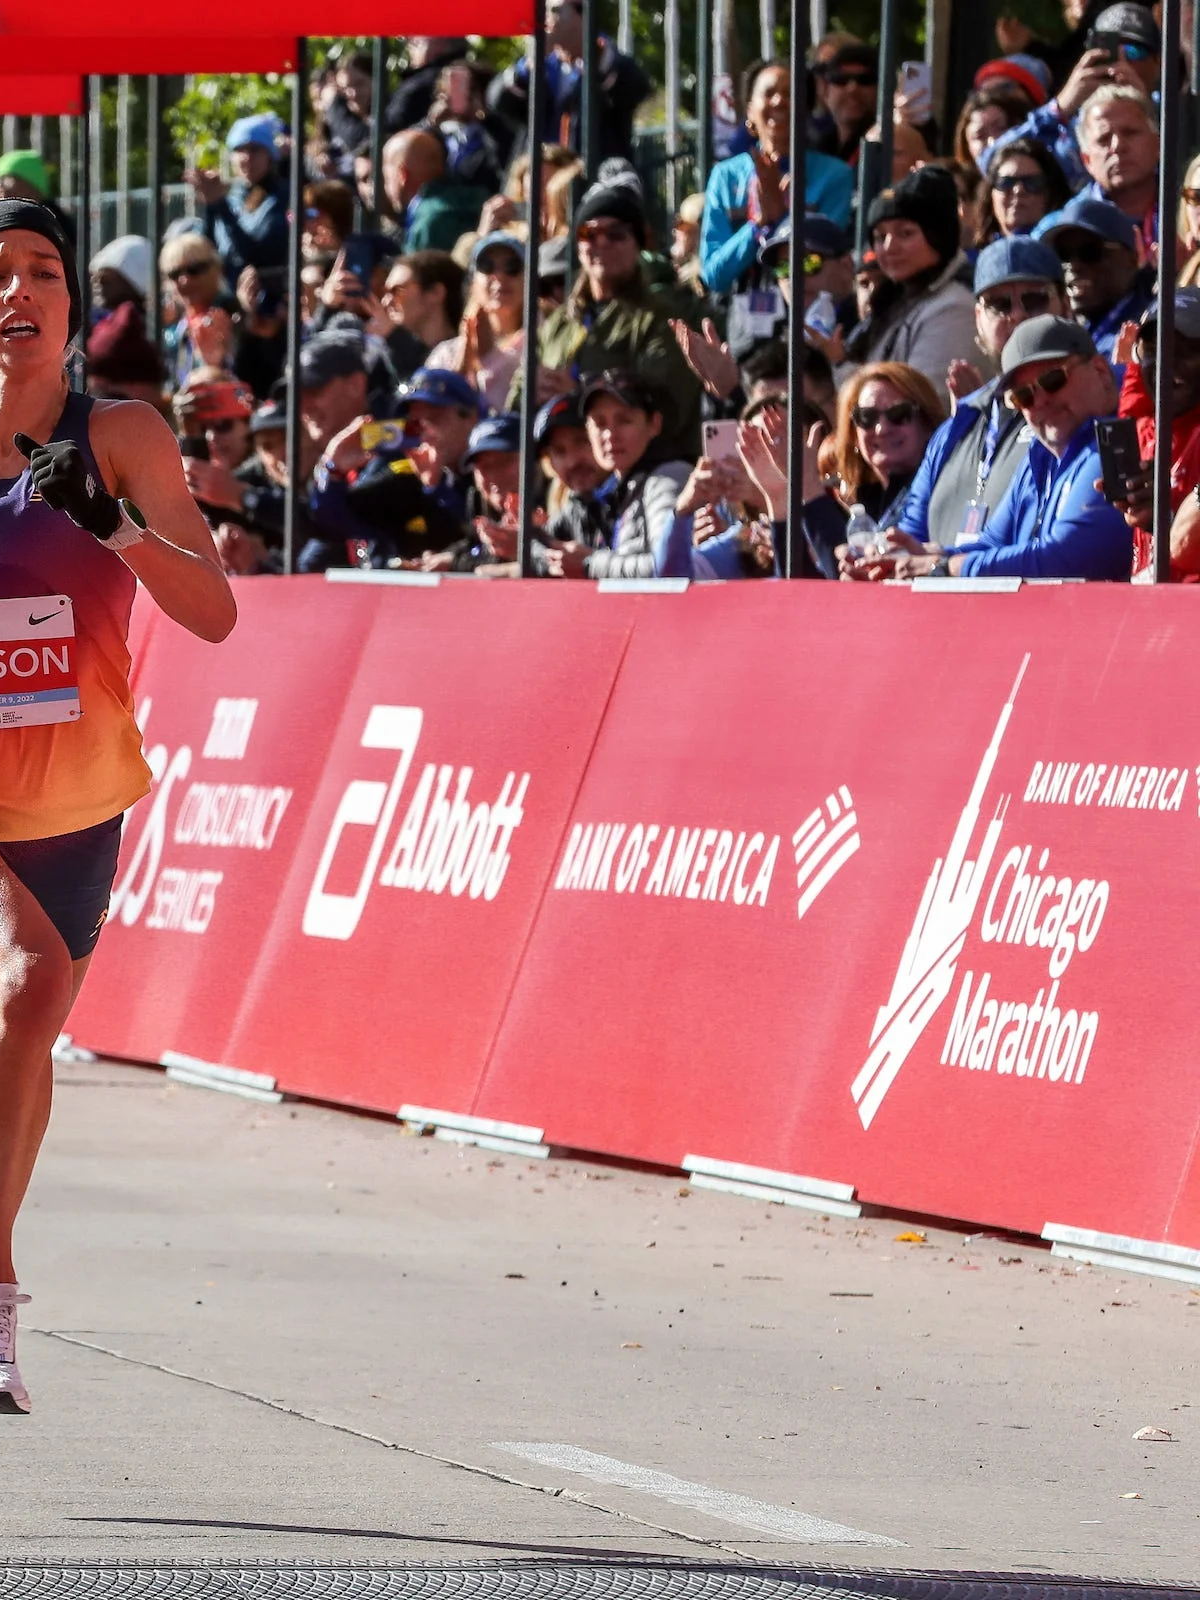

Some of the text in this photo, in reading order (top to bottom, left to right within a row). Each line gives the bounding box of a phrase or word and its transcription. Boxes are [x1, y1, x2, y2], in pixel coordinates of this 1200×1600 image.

[8, 696, 15, 704] 9,
[17, 694, 35, 703] 2022
[379, 763, 531, 901] Abbott
[1023, 760, 1189, 812] BANK OF AMERICA
[554, 822, 782, 907] BANK OF AMERICA
[981, 844, 1110, 979] Chicago
[939, 969, 1100, 1085] Marathon
